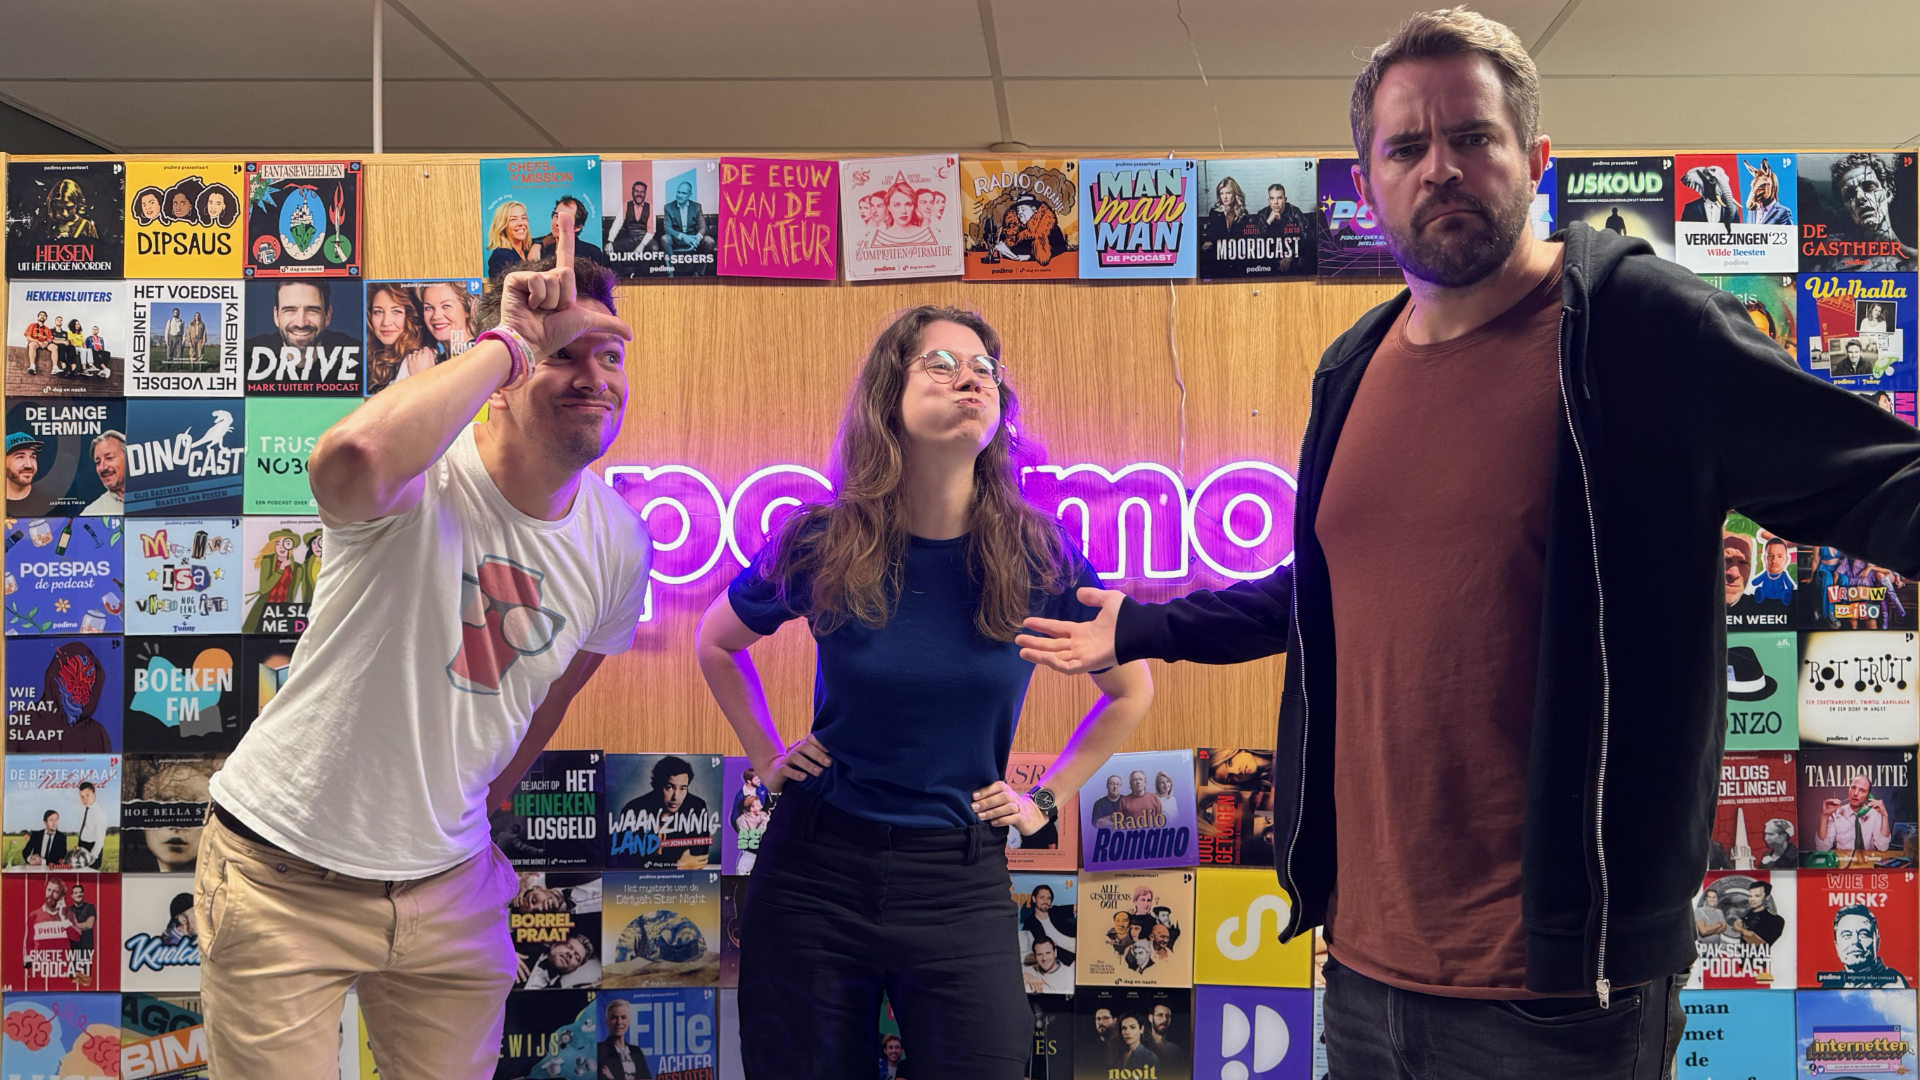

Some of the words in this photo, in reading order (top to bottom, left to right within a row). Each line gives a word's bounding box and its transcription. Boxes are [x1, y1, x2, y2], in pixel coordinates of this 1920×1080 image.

[263, 164, 343, 178] FANTASIEWERELDEN
[508, 161, 549, 173] CHEFS
[521, 171, 572, 184] MISSION
[721, 163, 755, 185] DE
[769, 165, 832, 189] EEUW
[1099, 168, 1182, 199] MAN
[1567, 171, 1663, 195] IJSKOUD
[974, 172, 1031, 197] RADIO
[1033, 179, 1064, 214] ORANJE
[723, 189, 776, 219] VAN
[784, 191, 822, 219] DE
[1094, 194, 1186, 225] man
[1097, 222, 1181, 251] MAN
[1803, 224, 1827, 239] DE
[137, 232, 232, 255] DIPSAUS
[724, 218, 833, 269] AMATEUR
[1216, 237, 1300, 260] MOORDCAST
[1802, 241, 1909, 259] GASTHEER
[35, 244, 93, 262] HEKSEN
[609, 251, 664, 262] DIJKHOFF
[670, 254, 714, 264] SEGERS
[1123, 254, 1172, 262] PODCAST
[1707, 248, 1732, 257] Wilde
[1733, 248, 1766, 256] Beesten
[18, 262, 30, 271] UIT
[32, 262, 46, 271] HET
[47, 262, 70, 271] HOGE
[72, 262, 111, 271] NOORDEN
[650, 265, 674, 273] podimo
[1246, 266, 1271, 274] podimo
[26, 290, 112, 302] HEKKENSLUITERS
[134, 286, 164, 299] HET
[168, 286, 239, 300] VOEDSEL
[1805, 277, 1908, 300] Walhalla
[247, 346, 360, 382] DRIVE
[248, 383, 276, 392] MARK
[277, 383, 314, 392] TUITERT
[316, 383, 359, 392] PODCAST
[25, 408, 47, 420] DE
[51, 406, 107, 420] LANGE
[31, 422, 101, 436] TERMIJN
[20, 560, 111, 578] POESPAS
[35, 579, 49, 590] de
[50, 576, 95, 593] podcast
[263, 606, 285, 618] AL
[1746, 615, 1787, 624] WEEK!
[53, 621, 78, 629] podimo
[263, 621, 288, 633] ME
[134, 668, 232, 692] BOEKEN
[10, 687, 36, 698] WIE
[9, 701, 57, 714] PRAAT,
[167, 697, 200, 721] FM
[9, 715, 30, 726] DIE
[1730, 711, 1782, 734] NZO
[9, 730, 64, 741] SLAAPT
[10, 769, 25, 781] DE
[1722, 765, 1769, 780] RLOGS
[1805, 764, 1908, 787] TAALPOLITIE
[521, 781, 529, 791] DE
[530, 781, 550, 791] JACHT
[551, 781, 560, 790] OP
[566, 770, 597, 793] HET
[154, 808, 191, 816] BELLA
[514, 793, 595, 817] HEINEKEN
[609, 808, 721, 835] WAANZINNIG
[1112, 810, 1166, 830] Radio
[527, 817, 597, 840] LOSGELD
[610, 830, 660, 857] LAND
[1092, 826, 1189, 863] Romano
[1827, 874, 1863, 889] WIE
[1871, 874, 1889, 889] IS
[654, 894, 677, 904] Star
[679, 894, 706, 905] Night
[1828, 893, 1888, 907] MUSK?
[511, 913, 575, 928] BORREL
[516, 928, 570, 943] PRAAT
[31, 950, 63, 961] SKIETE
[65, 950, 94, 961] WILLY
[32, 961, 92, 978] PODCAST
[1700, 958, 1772, 978] PODCAST
[1684, 1003, 1729, 1015] man
[630, 1001, 712, 1056] Ellie
[1684, 1028, 1724, 1041] met
[1815, 1038, 1909, 1052] internetten
[658, 1054, 712, 1074] ACHTER
[1685, 1052, 1709, 1067] de
[1109, 1064, 1156, 1079] nooit
